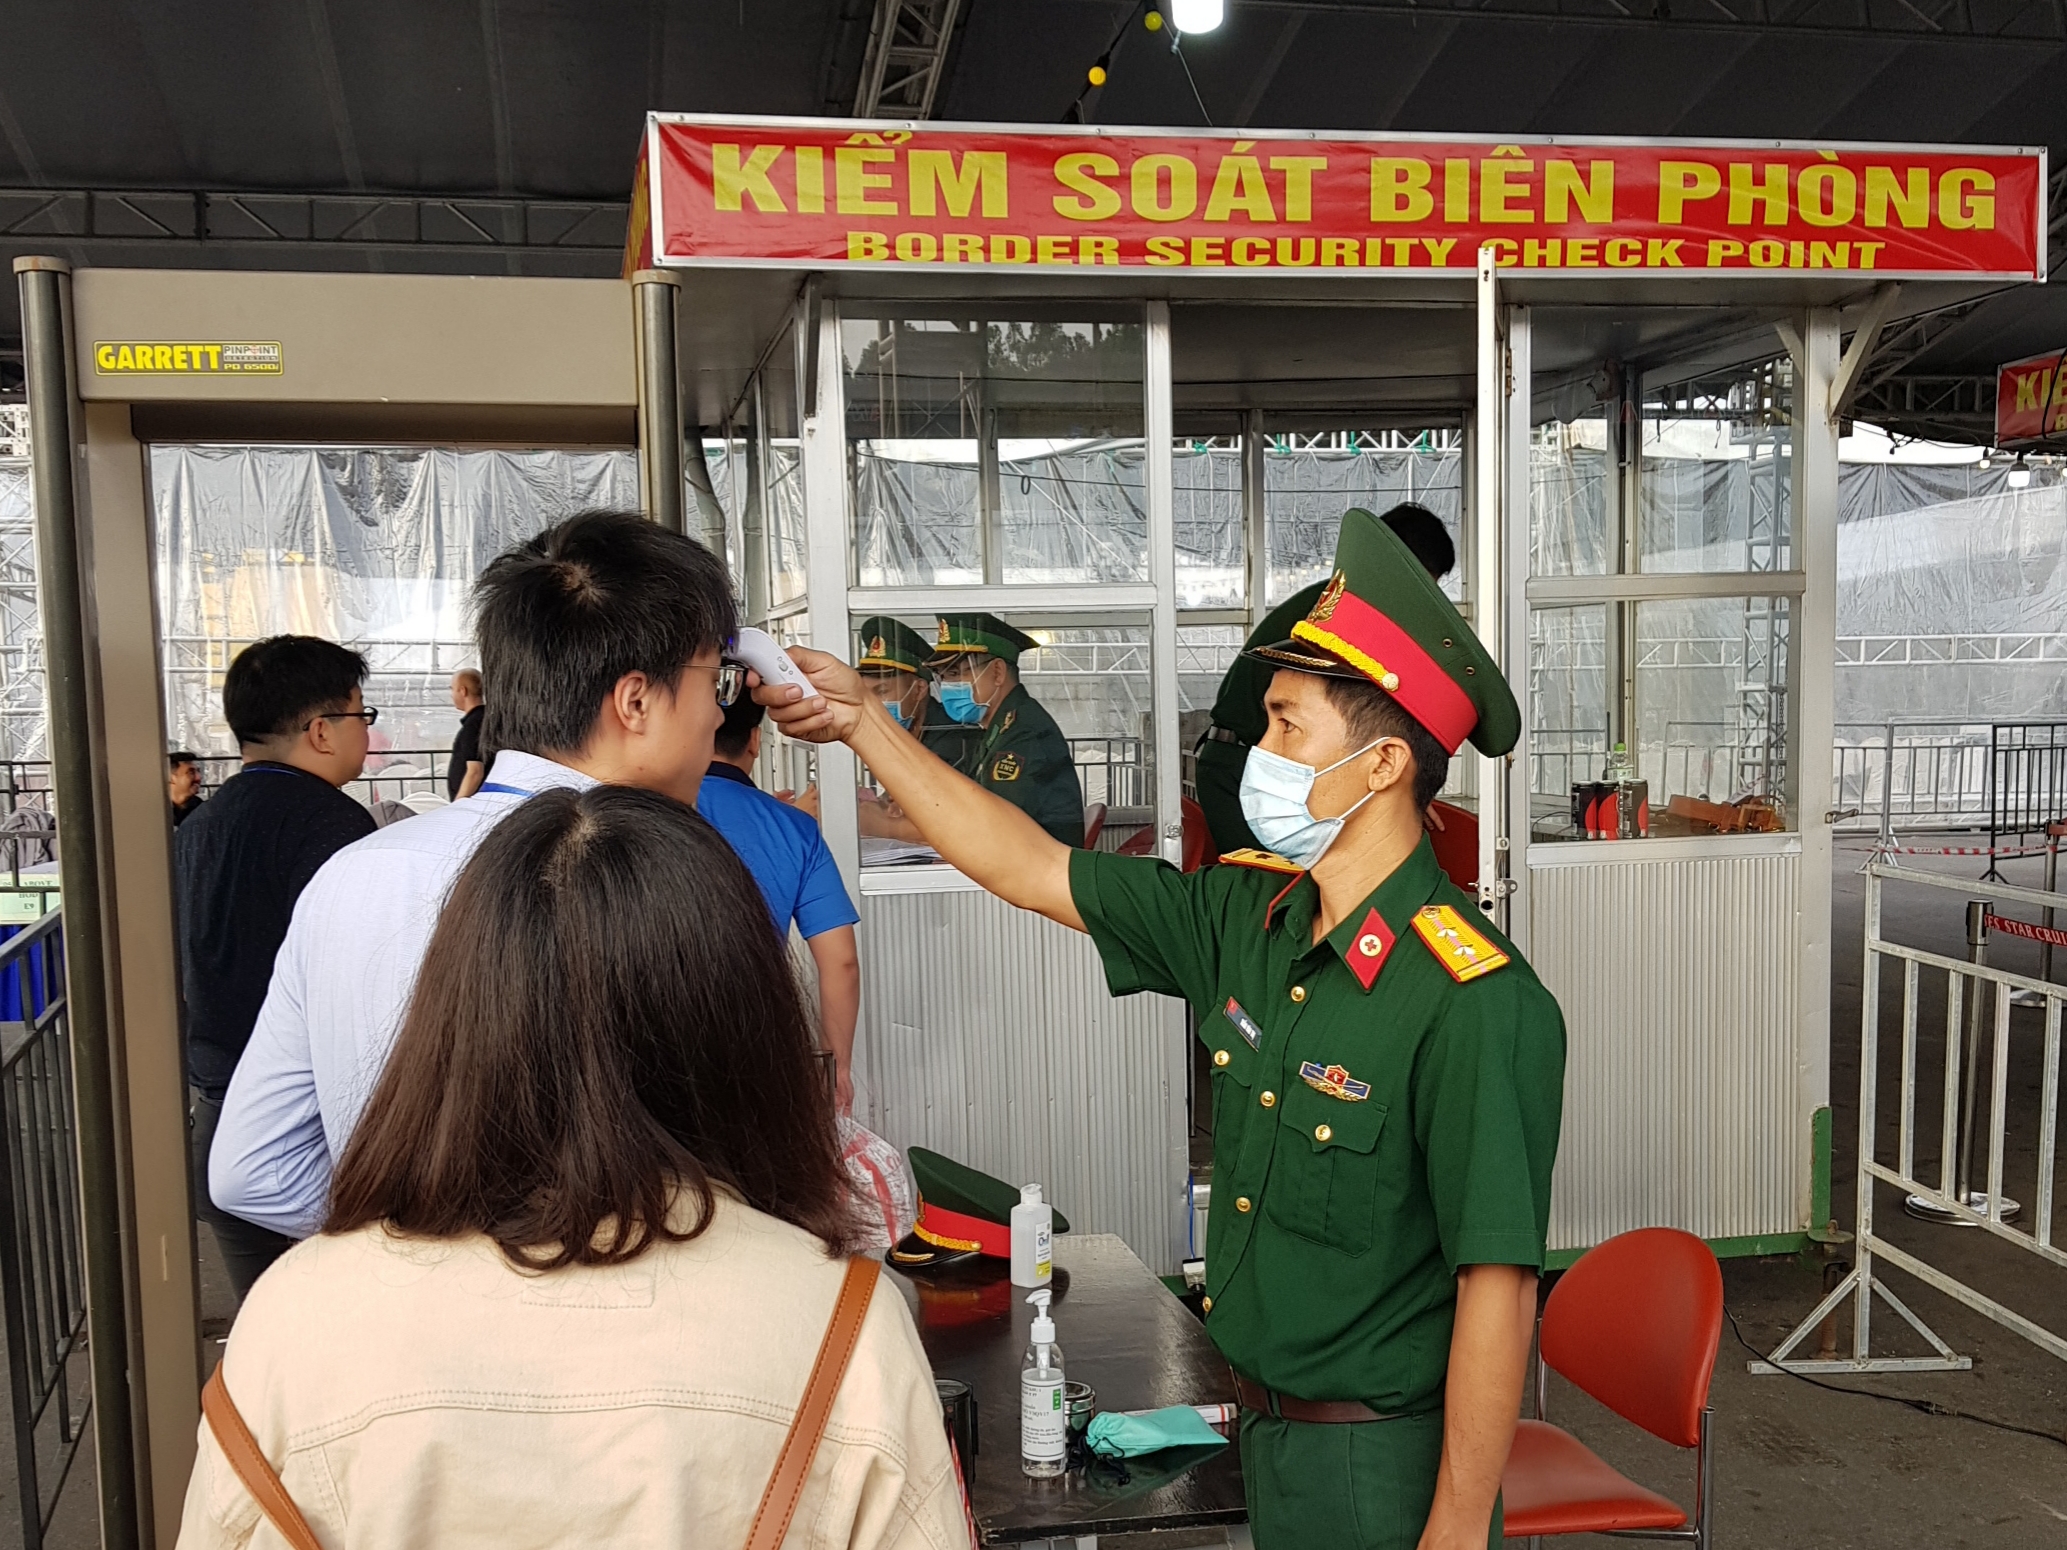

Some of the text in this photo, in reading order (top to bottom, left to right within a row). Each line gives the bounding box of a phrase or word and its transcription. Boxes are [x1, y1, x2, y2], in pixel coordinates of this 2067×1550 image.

[712, 130, 1008, 218] KIỂM
[1053, 139, 1327, 222] SOÁT
[1371, 144, 1614, 224] BIÊN
[1658, 150, 1996, 230] PHÒNG
[847, 232, 1886, 271] BORDER SECURITY CHECK POINT
[97, 345, 222, 371] GARRETT
[2004, 919, 2036, 939] STAR
